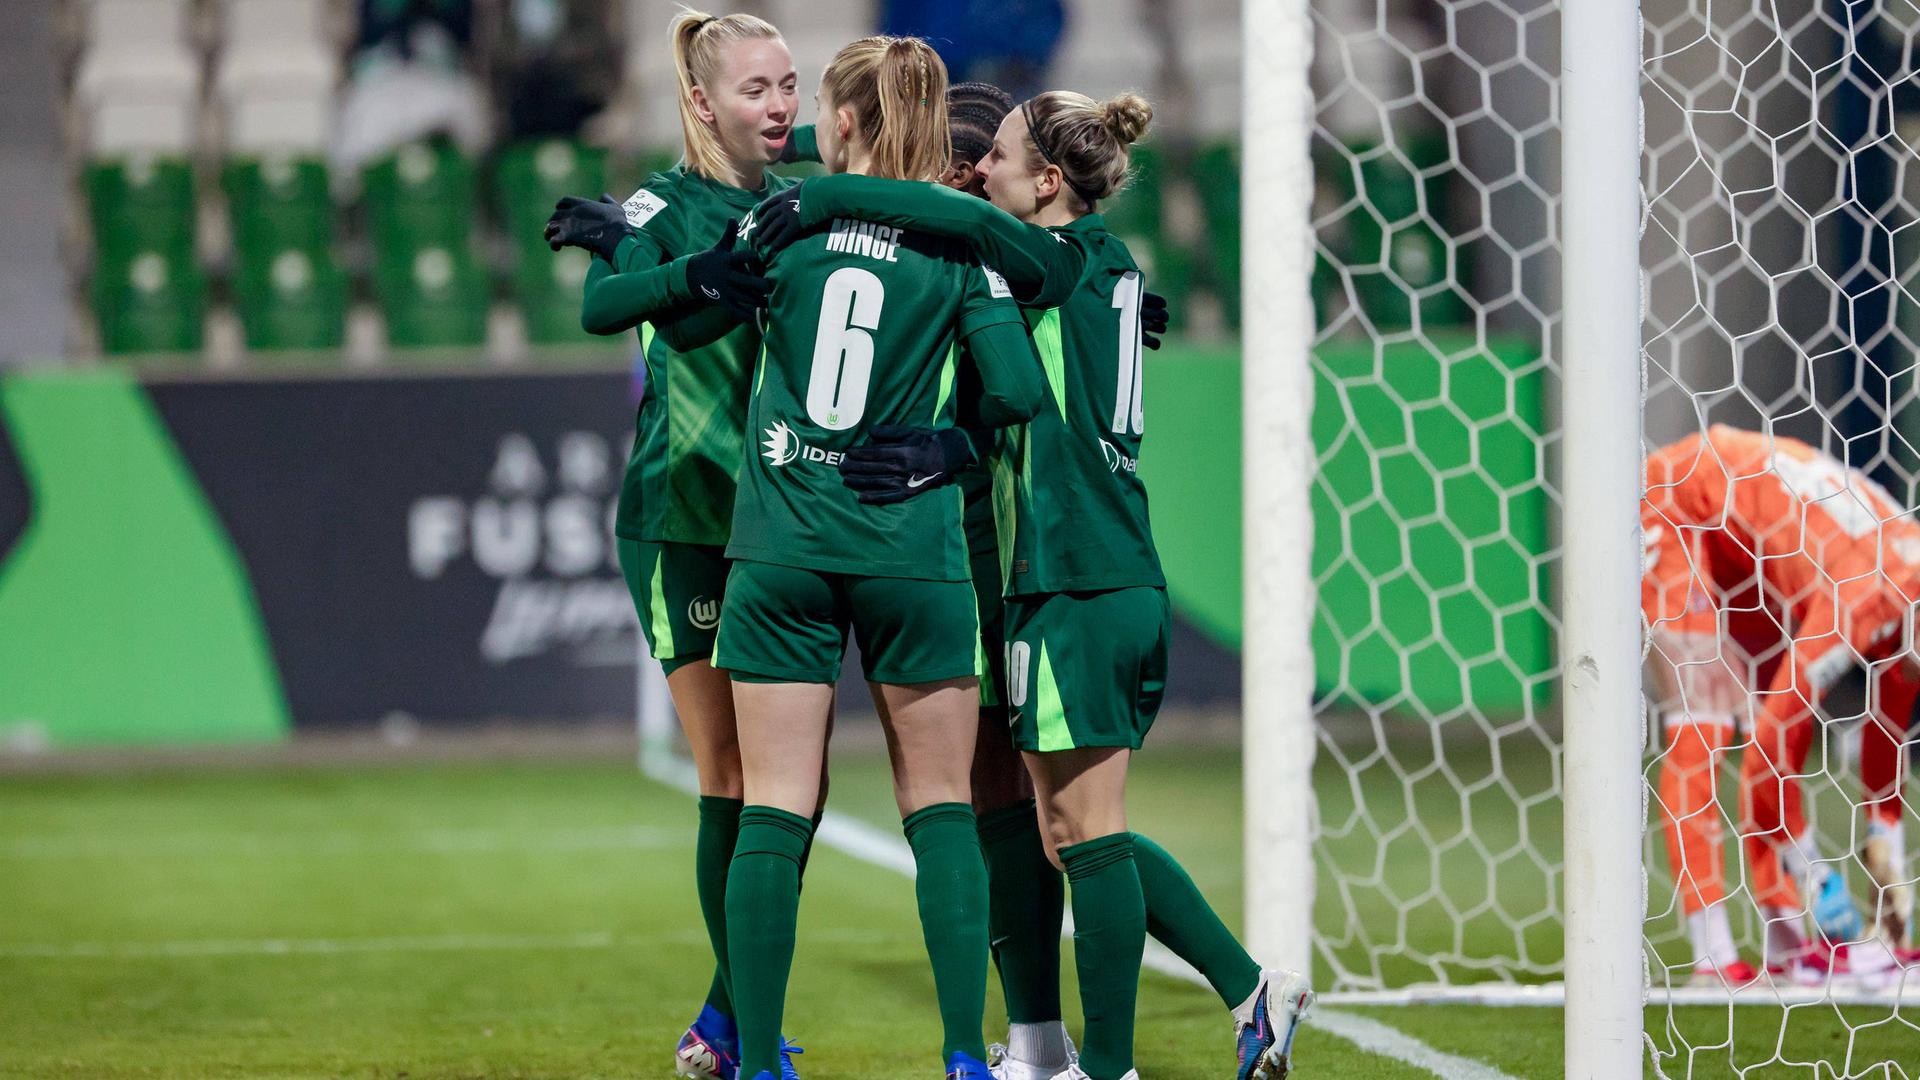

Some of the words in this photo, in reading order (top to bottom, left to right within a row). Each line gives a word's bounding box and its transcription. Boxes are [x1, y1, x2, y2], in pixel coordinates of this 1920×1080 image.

[826, 218, 904, 262] MINGE
[806, 267, 885, 430] 6
[407, 496, 620, 578] FUS
